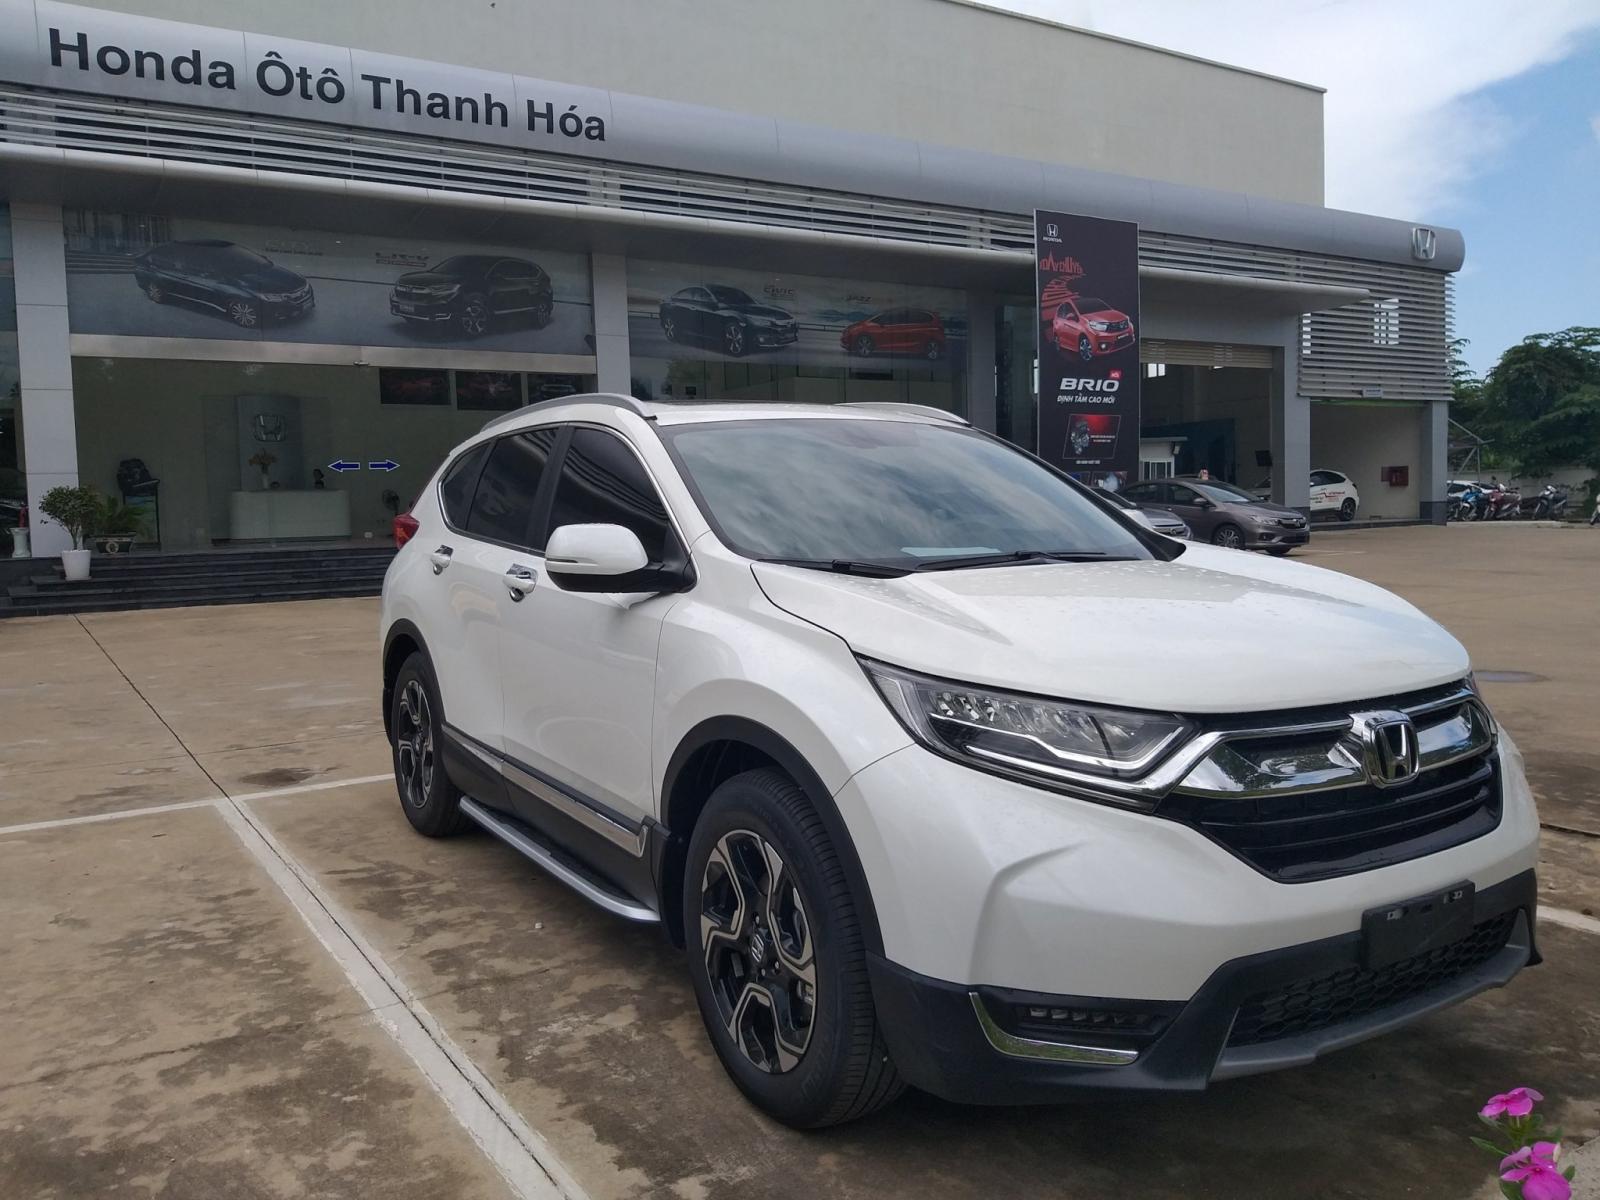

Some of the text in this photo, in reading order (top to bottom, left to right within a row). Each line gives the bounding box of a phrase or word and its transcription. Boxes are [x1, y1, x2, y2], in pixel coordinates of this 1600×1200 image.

[49, 28, 606, 142] Honda Ôtô Thanh Hóa
[1060, 378, 1120, 392] BRIO
[1088, 395, 1102, 404] CAO
